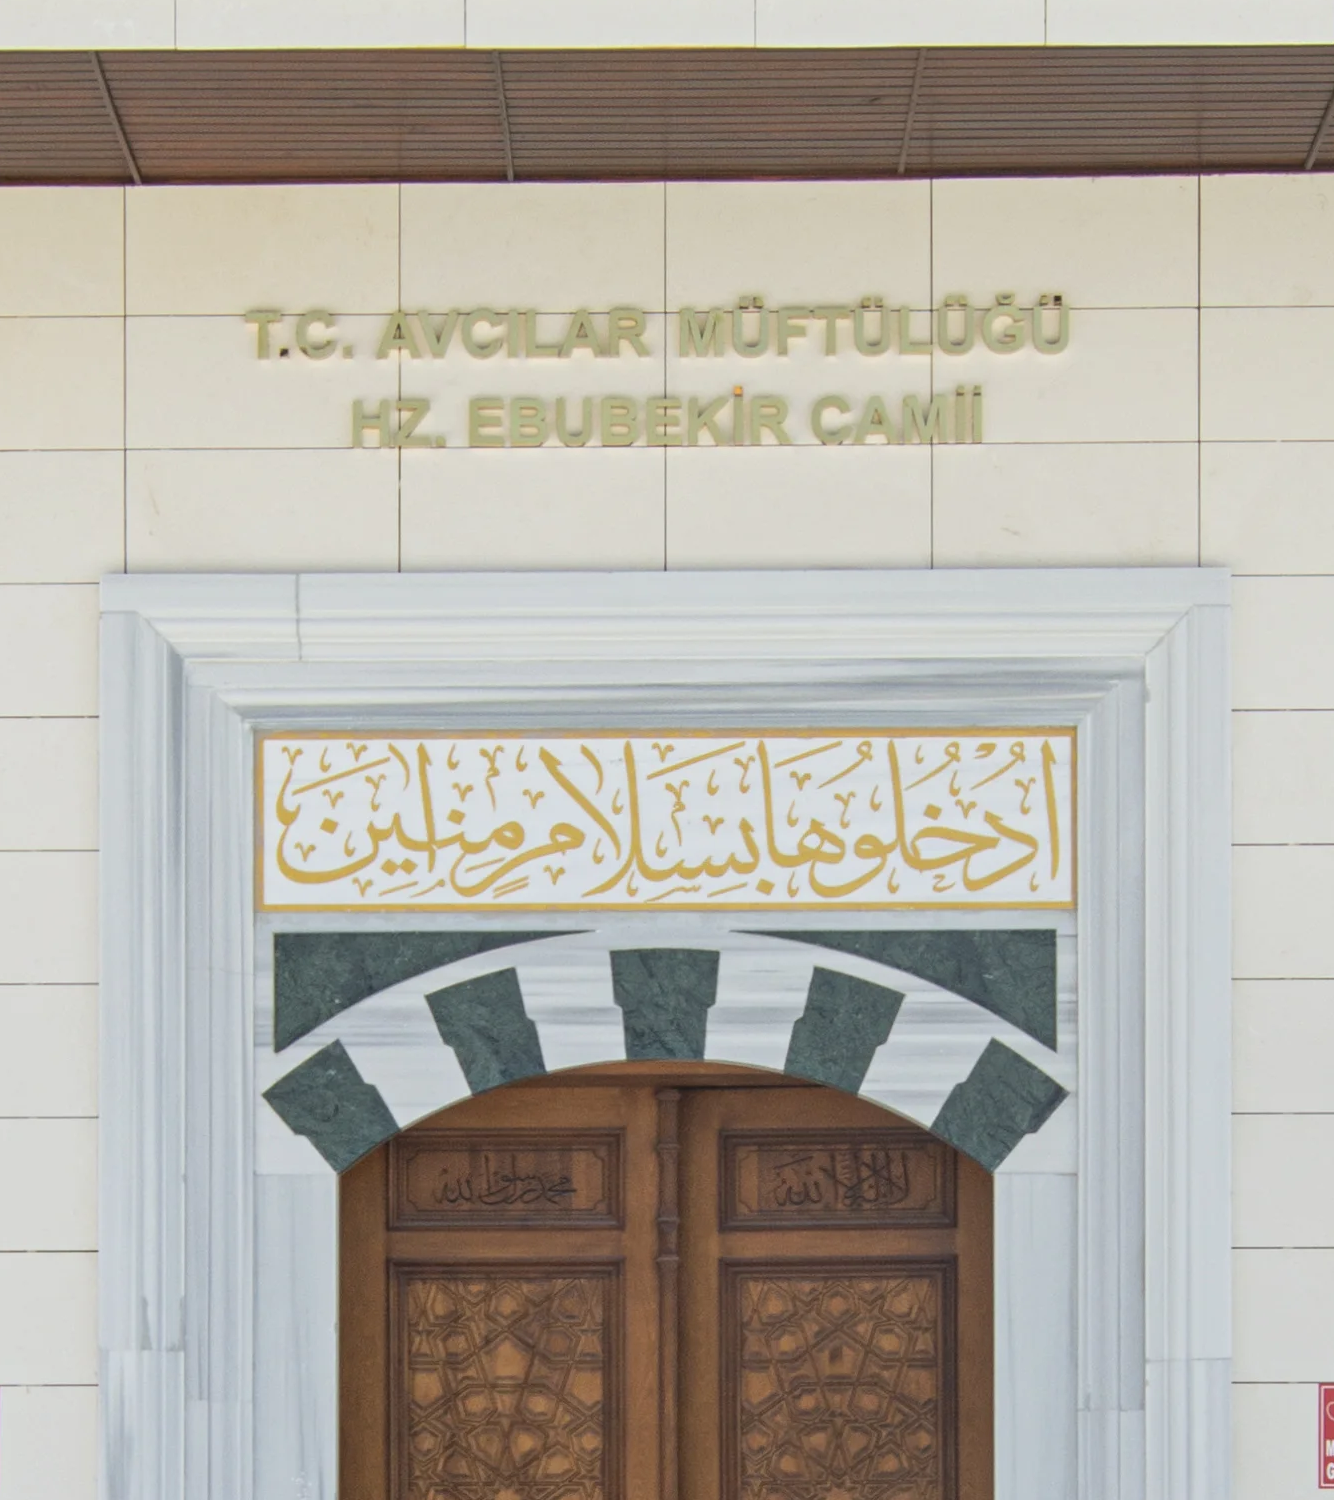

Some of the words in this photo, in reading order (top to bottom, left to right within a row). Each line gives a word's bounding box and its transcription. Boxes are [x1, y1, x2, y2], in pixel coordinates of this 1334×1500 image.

[245, 308, 355, 361] T.C.
[376, 306, 651, 361] AVCILAR
[678, 292, 1069, 358] MÜFTÜLÜĞÜ
[351, 398, 447, 449] HZ.
[469, 385, 794, 449] EBUBEKİR
[810, 385, 984, 446] CAMİİ
